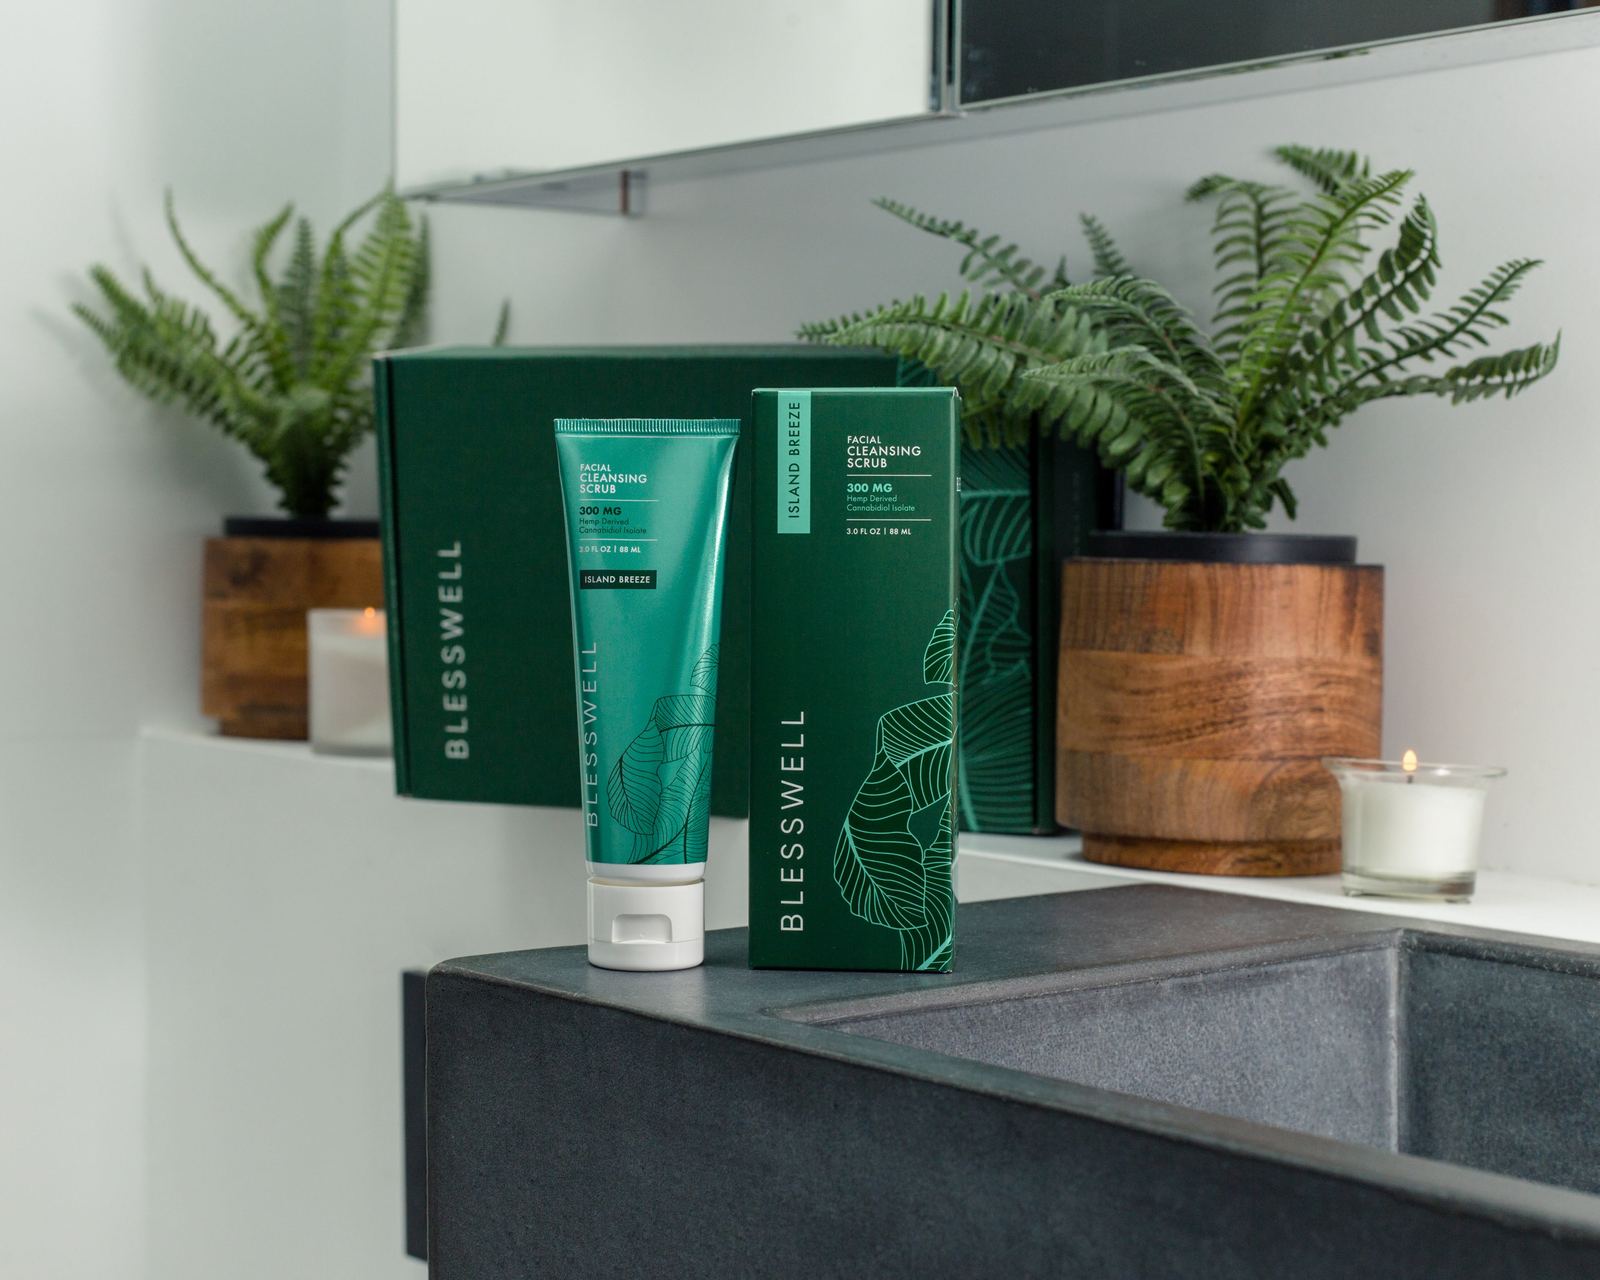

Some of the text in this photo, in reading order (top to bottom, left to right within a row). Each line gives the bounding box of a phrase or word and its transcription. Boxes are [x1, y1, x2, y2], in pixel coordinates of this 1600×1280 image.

[847, 435, 882, 444] FACIAL
[847, 446, 922, 456] CLEANSING
[788, 402, 800, 518] ISLAND BREEZE
[847, 458, 887, 468] SCRUB
[580, 464, 611, 472] FACIAL
[580, 473, 648, 483] CLEANSING
[580, 484, 616, 493] SCRUB
[847, 483, 893, 493] 300 MG
[847, 495, 898, 503] Hemp Derived
[579, 506, 622, 515] 300 MG
[847, 504, 890, 512] Cannabidiol
[579, 518, 600, 526] Hemp
[618, 576, 651, 584] BREEZE
[437, 540, 470, 760] BLESSWELL
[582, 642, 598, 827] BLESSWELL
[781, 711, 804, 931] BLESSWELL
